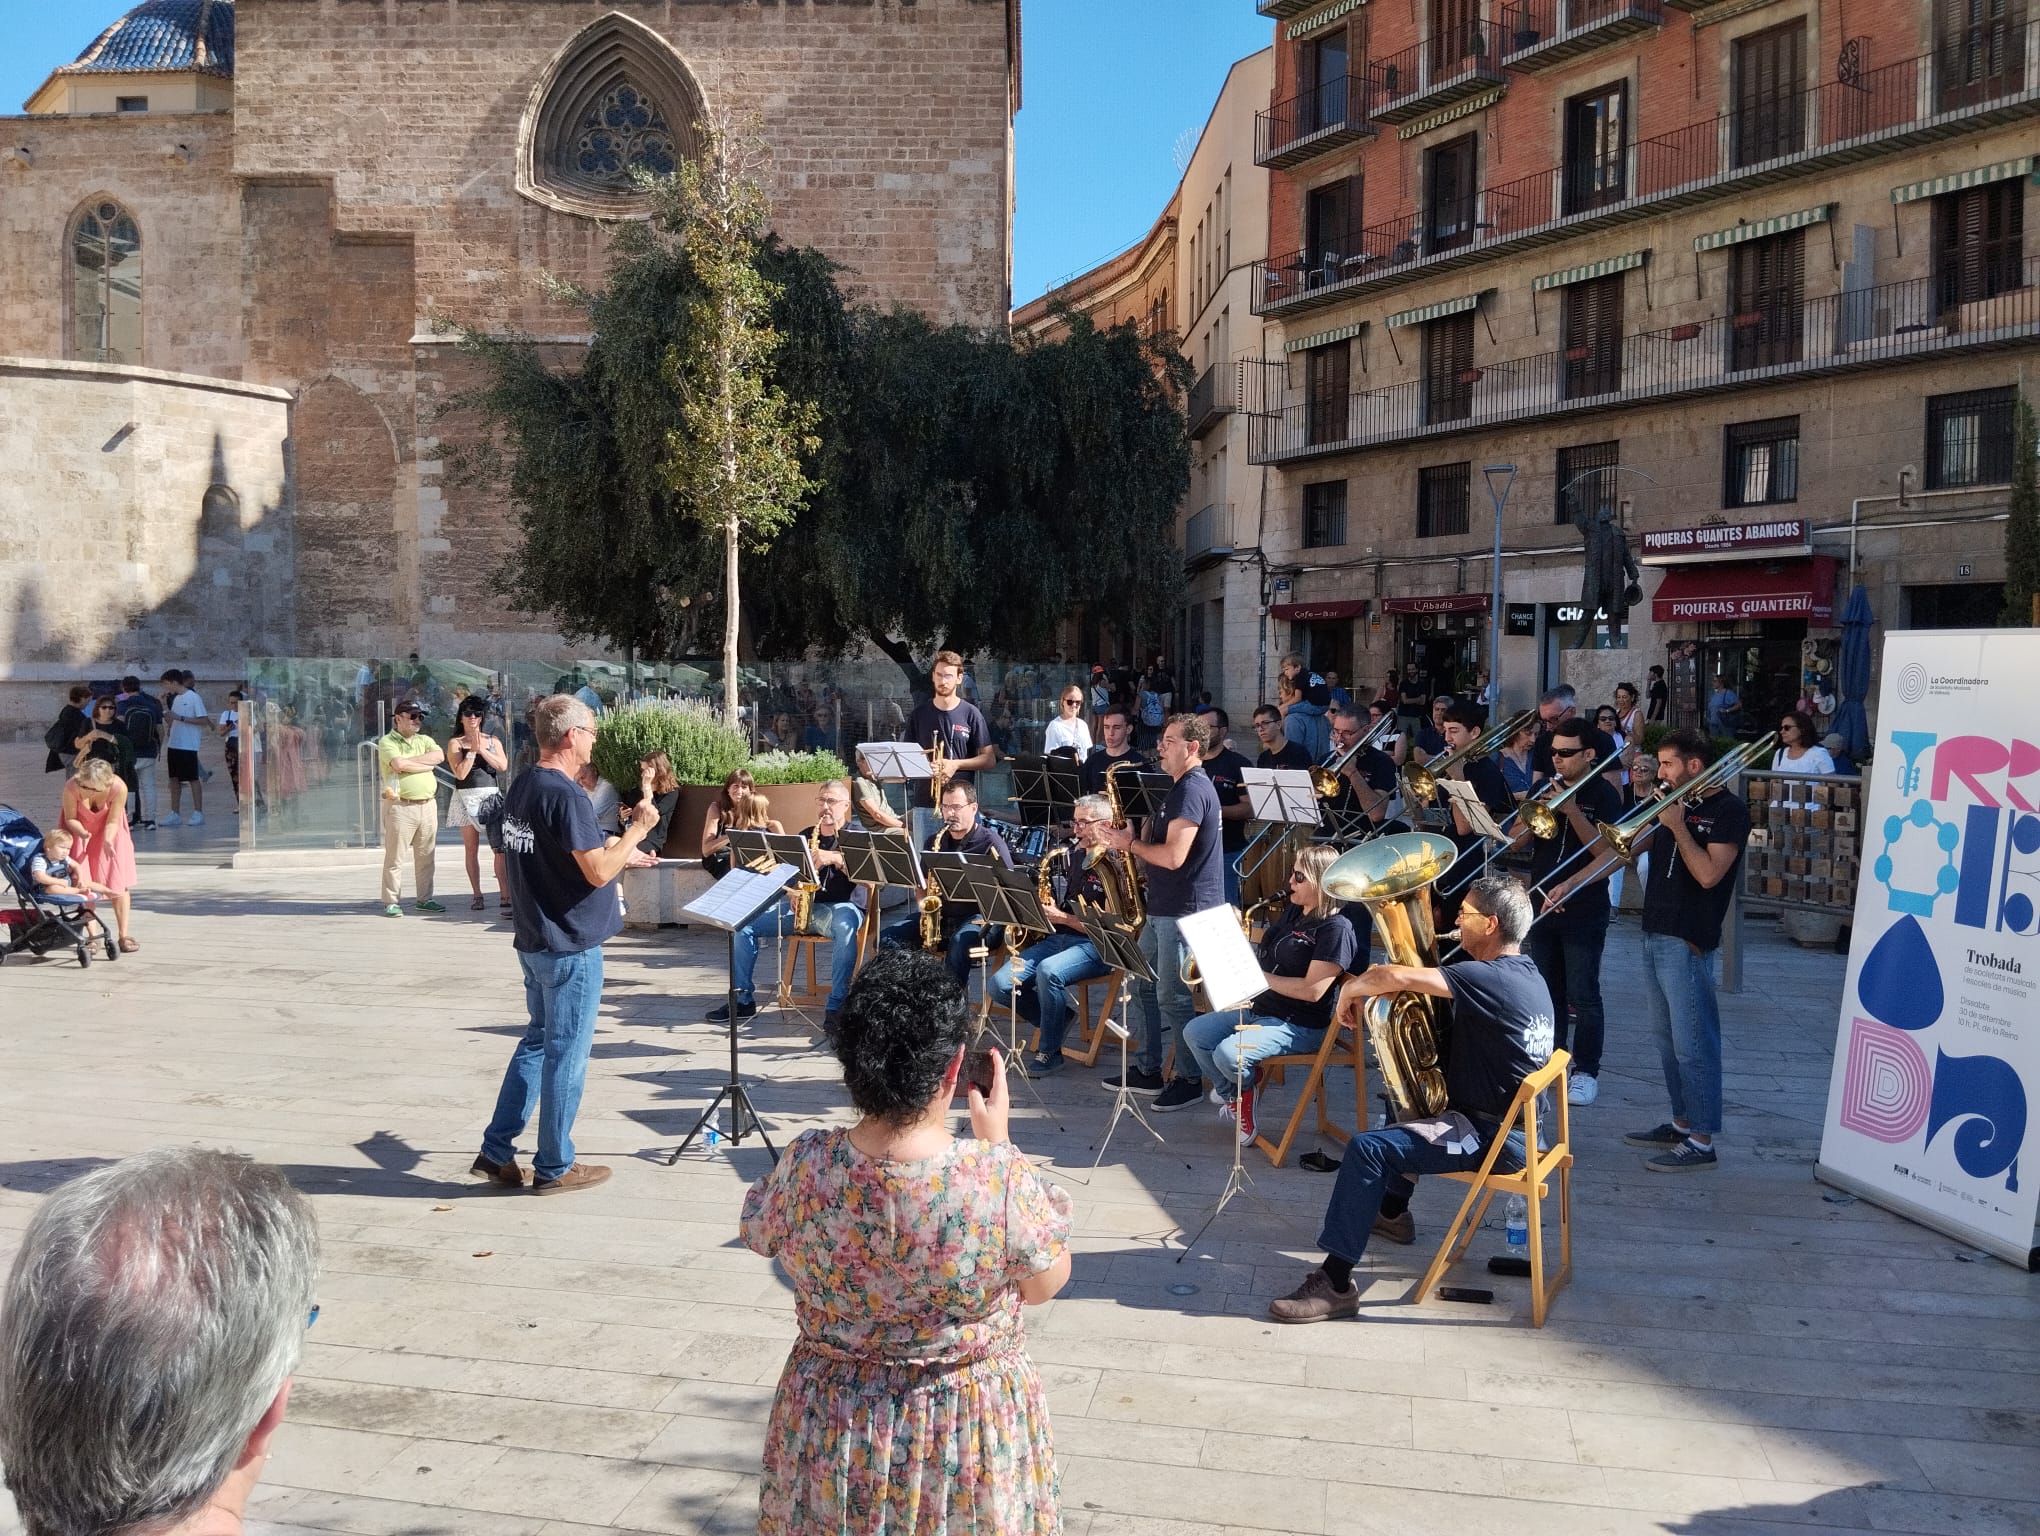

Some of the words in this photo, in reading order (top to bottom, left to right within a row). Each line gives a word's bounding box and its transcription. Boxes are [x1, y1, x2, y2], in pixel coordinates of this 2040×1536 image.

[1645, 531, 1693, 548] PIQUERAS
[1696, 527, 1743, 543] GUANTES
[1745, 522, 1800, 539] ABANICOS
[1672, 601, 1735, 617] PIQUERAS
[1939, 676, 1989, 686] Coordinadora
[1967, 949, 2021, 974] Trobada
[1964, 966, 1973, 974] de
[1974, 968, 2006, 982] societats
[2006, 977, 2037, 990] musicals
[1966, 977, 1992, 989] escoles
[1992, 984, 2002, 992] de
[1960, 996, 1990, 1010] Dissabte
[1959, 1007, 1968, 1015] 30
[1968, 1010, 1978, 1018] de
[1978, 1013, 2012, 1027] setembre
[1958, 1017, 1965, 1026] 10
[1982, 1024, 1991, 1032] de
[1992, 1026, 1999, 1035] la
[1999, 1029, 2019, 1040] Reina
